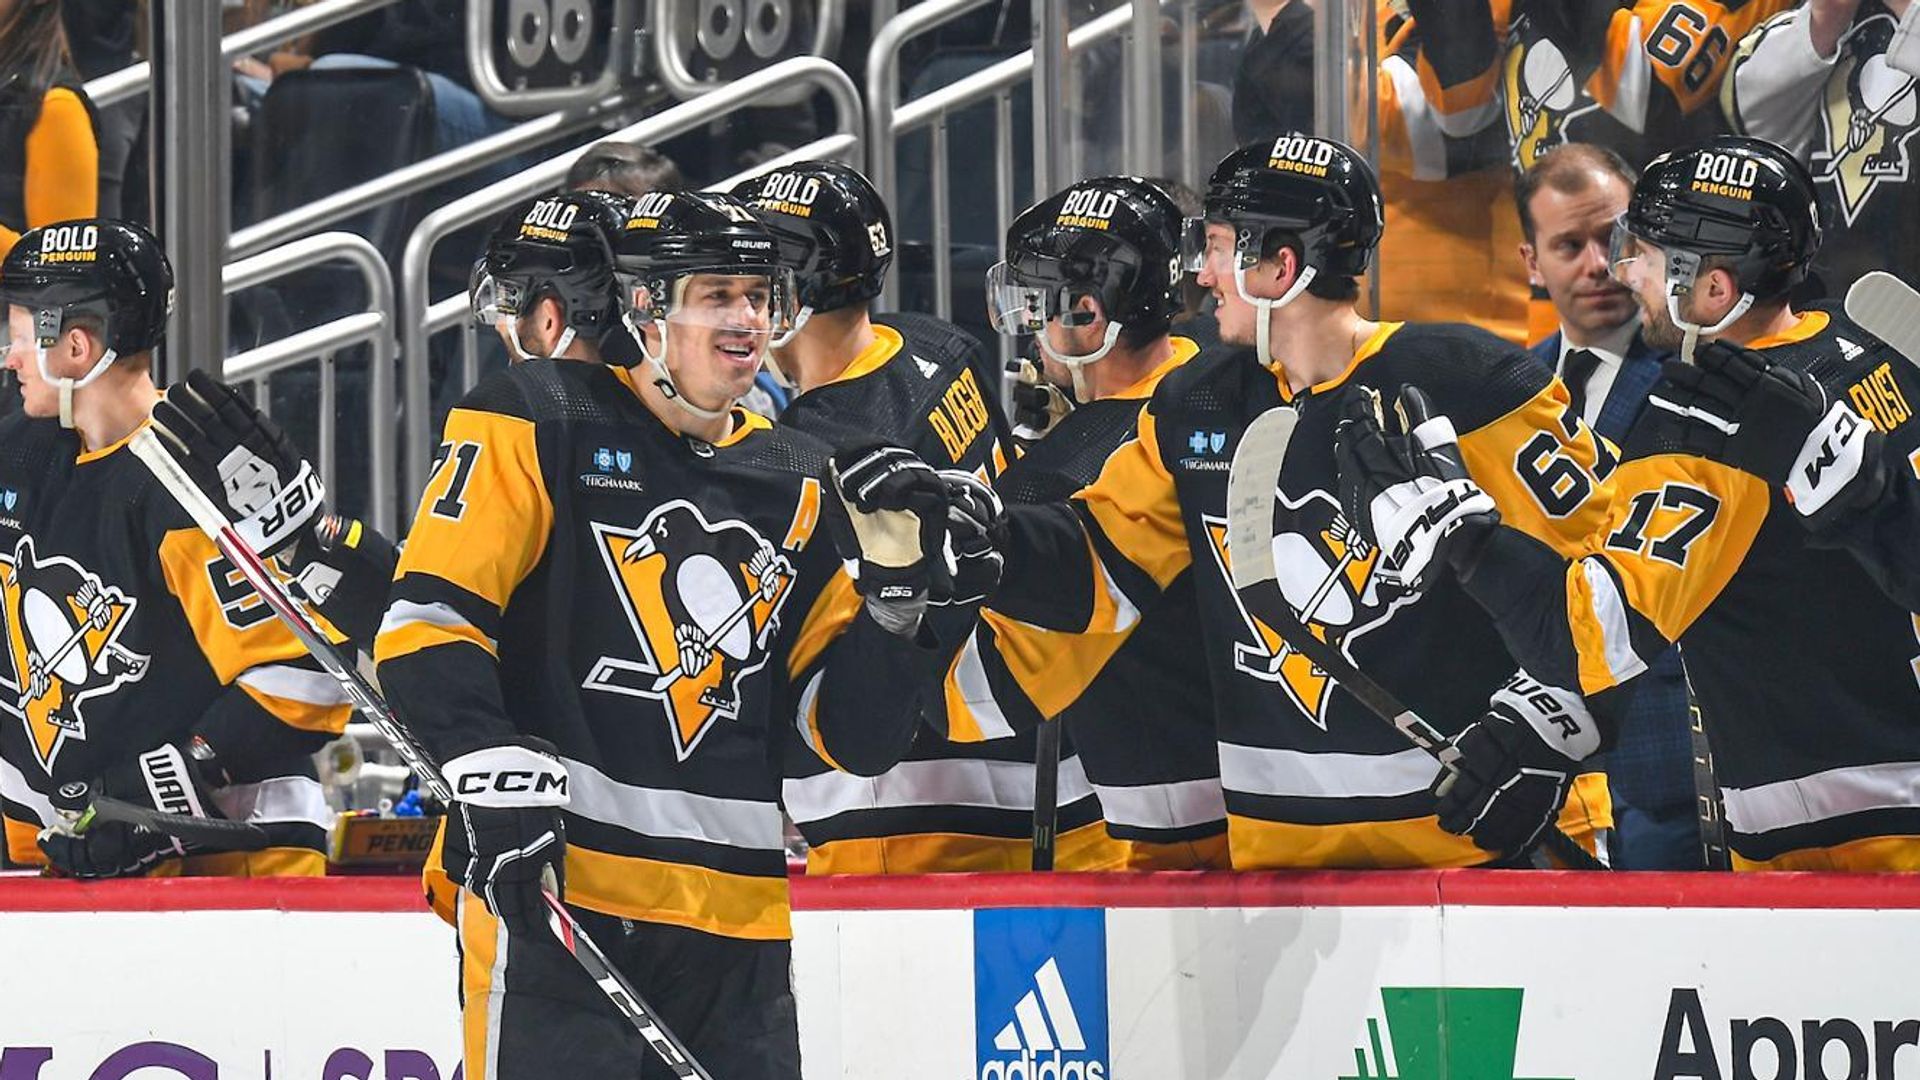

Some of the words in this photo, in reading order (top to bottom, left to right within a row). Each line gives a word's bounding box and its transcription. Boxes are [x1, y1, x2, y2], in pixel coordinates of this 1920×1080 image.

[1643, 2, 1730, 93] 66
[1270, 137, 1333, 166] BOLD
[1268, 159, 1327, 177] PENGUIN
[1695, 153, 1760, 188] BOLD
[763, 172, 821, 205] BOLD
[1060, 190, 1119, 218] BOLD
[1692, 181, 1753, 200] PENGUIN
[523, 200, 579, 231] BOLD
[758, 199, 813, 218] PENGUIN
[1056, 215, 1110, 230] PENGUIN
[41, 226, 98, 253] BOLD
[520, 225, 568, 242] PENGUIN
[732, 239, 772, 250] BAUER
[867, 221, 888, 252] 53
[40, 251, 96, 263] PENGUIN
[1848, 362, 1913, 434] RUST
[427, 440, 483, 523] 71
[257, 472, 323, 539] UER
[782, 477, 821, 552] A
[1390, 483, 1482, 572] TRUE
[1604, 480, 1723, 571] 17
[457, 770, 570, 797] CCM
[597, 971, 712, 1080] CC
[1653, 988, 1920, 1080] Appr
[981, 1049, 1105, 1080] adidas
